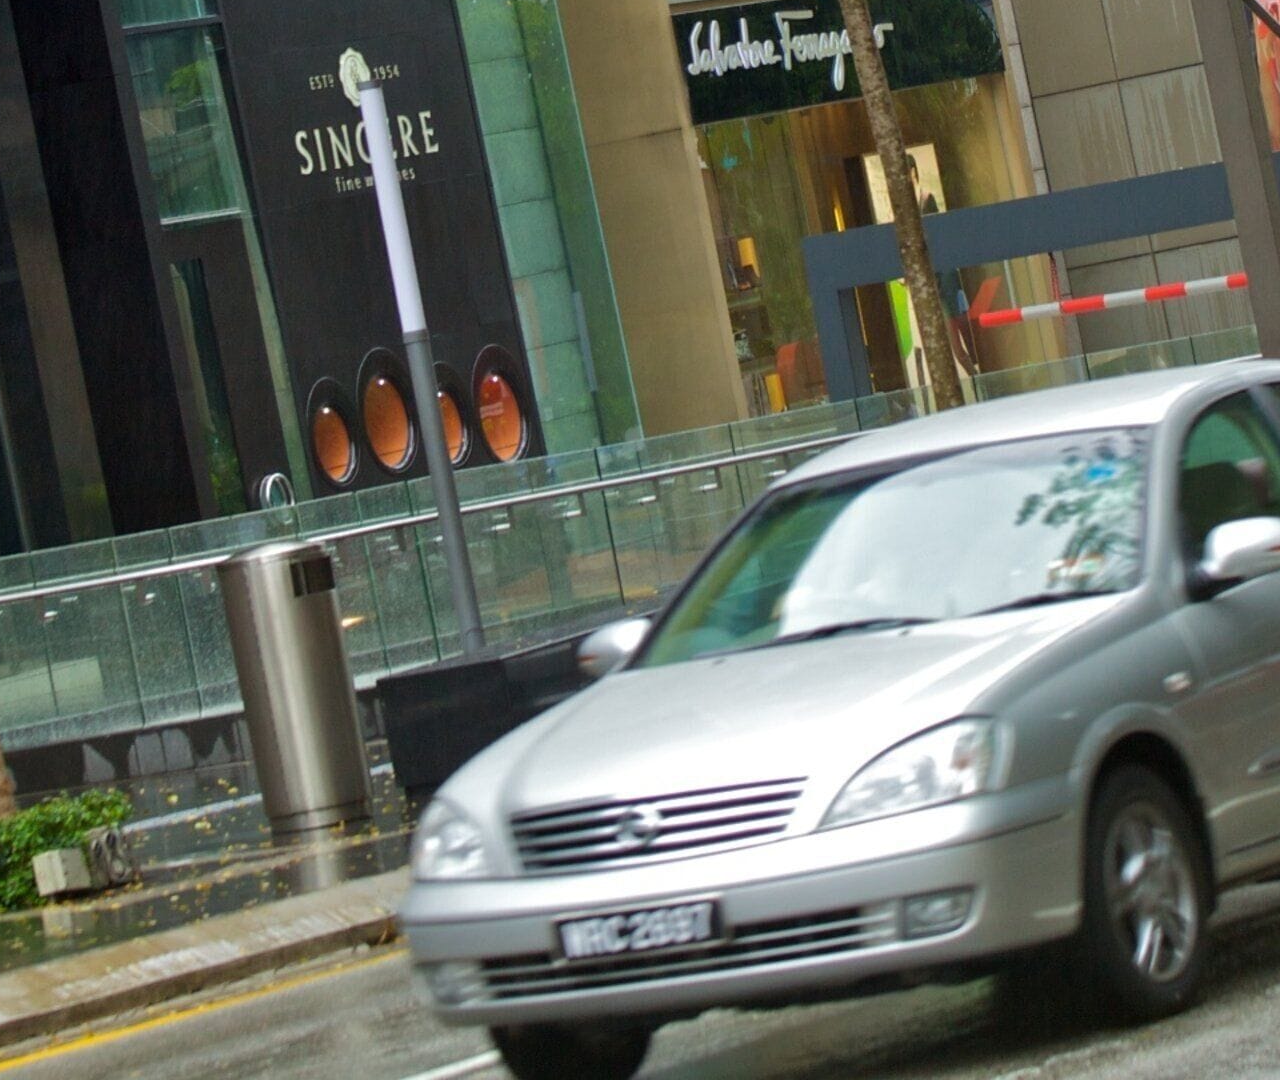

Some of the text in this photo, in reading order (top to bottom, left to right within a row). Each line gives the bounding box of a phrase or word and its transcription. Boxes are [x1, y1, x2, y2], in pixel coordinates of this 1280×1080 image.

[688, 9, 894, 92] Salvatore Ferragao
[372, 64, 400, 81] 1954
[295, 110, 439, 176] SINCRE
[335, 175, 362, 193] fine
